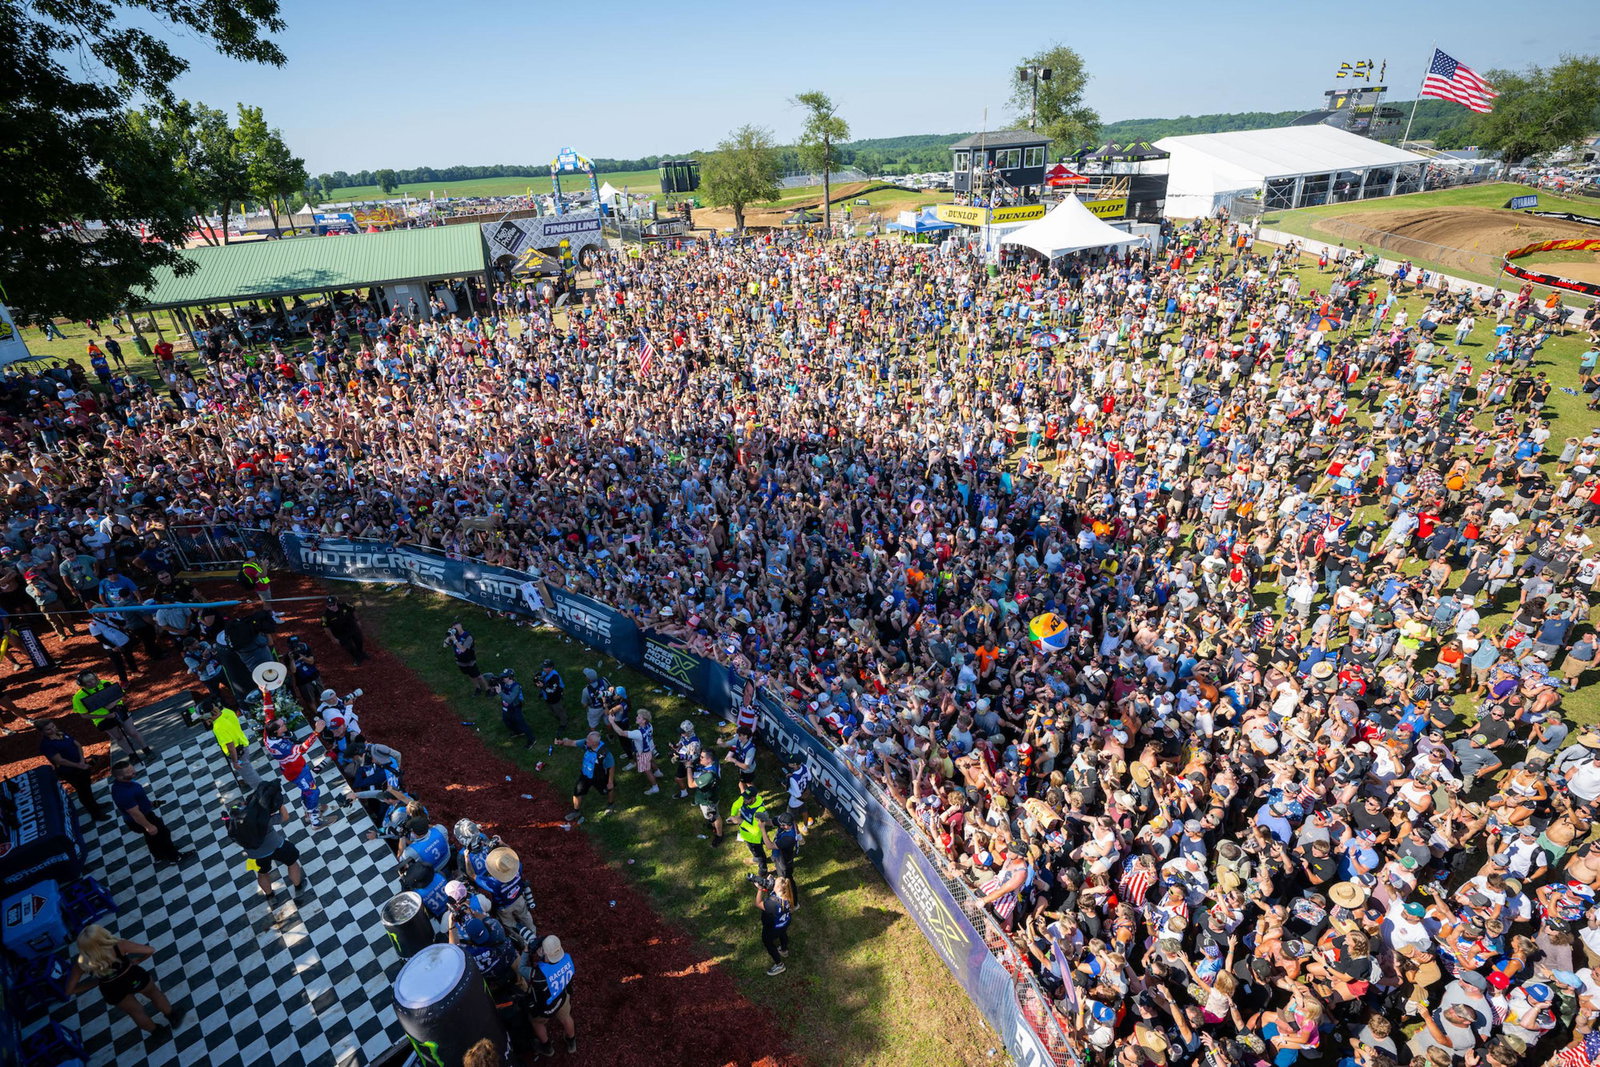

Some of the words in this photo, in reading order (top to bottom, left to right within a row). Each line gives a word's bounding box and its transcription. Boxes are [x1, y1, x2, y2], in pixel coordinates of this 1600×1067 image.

[948, 209, 978, 220] DUNLOP
[997, 210, 1043, 220] DUNLOP
[544, 222, 577, 234] FINISH
[577, 220, 598, 230] LINE
[355, 545, 395, 554] PRO
[645, 641, 674, 660] SUPER
[647, 648, 672, 665] MOTO
[644, 653, 672, 671] CROSS
[431, 847, 441, 860] 3
[906, 861, 937, 908] SUPER
[906, 870, 933, 912] MOTO
[902, 875, 932, 919] CROSS
[901, 884, 919, 911] WORLD
[918, 911, 960, 970] CHAMPIONSHIP
[548, 961, 572, 982] RACERX
